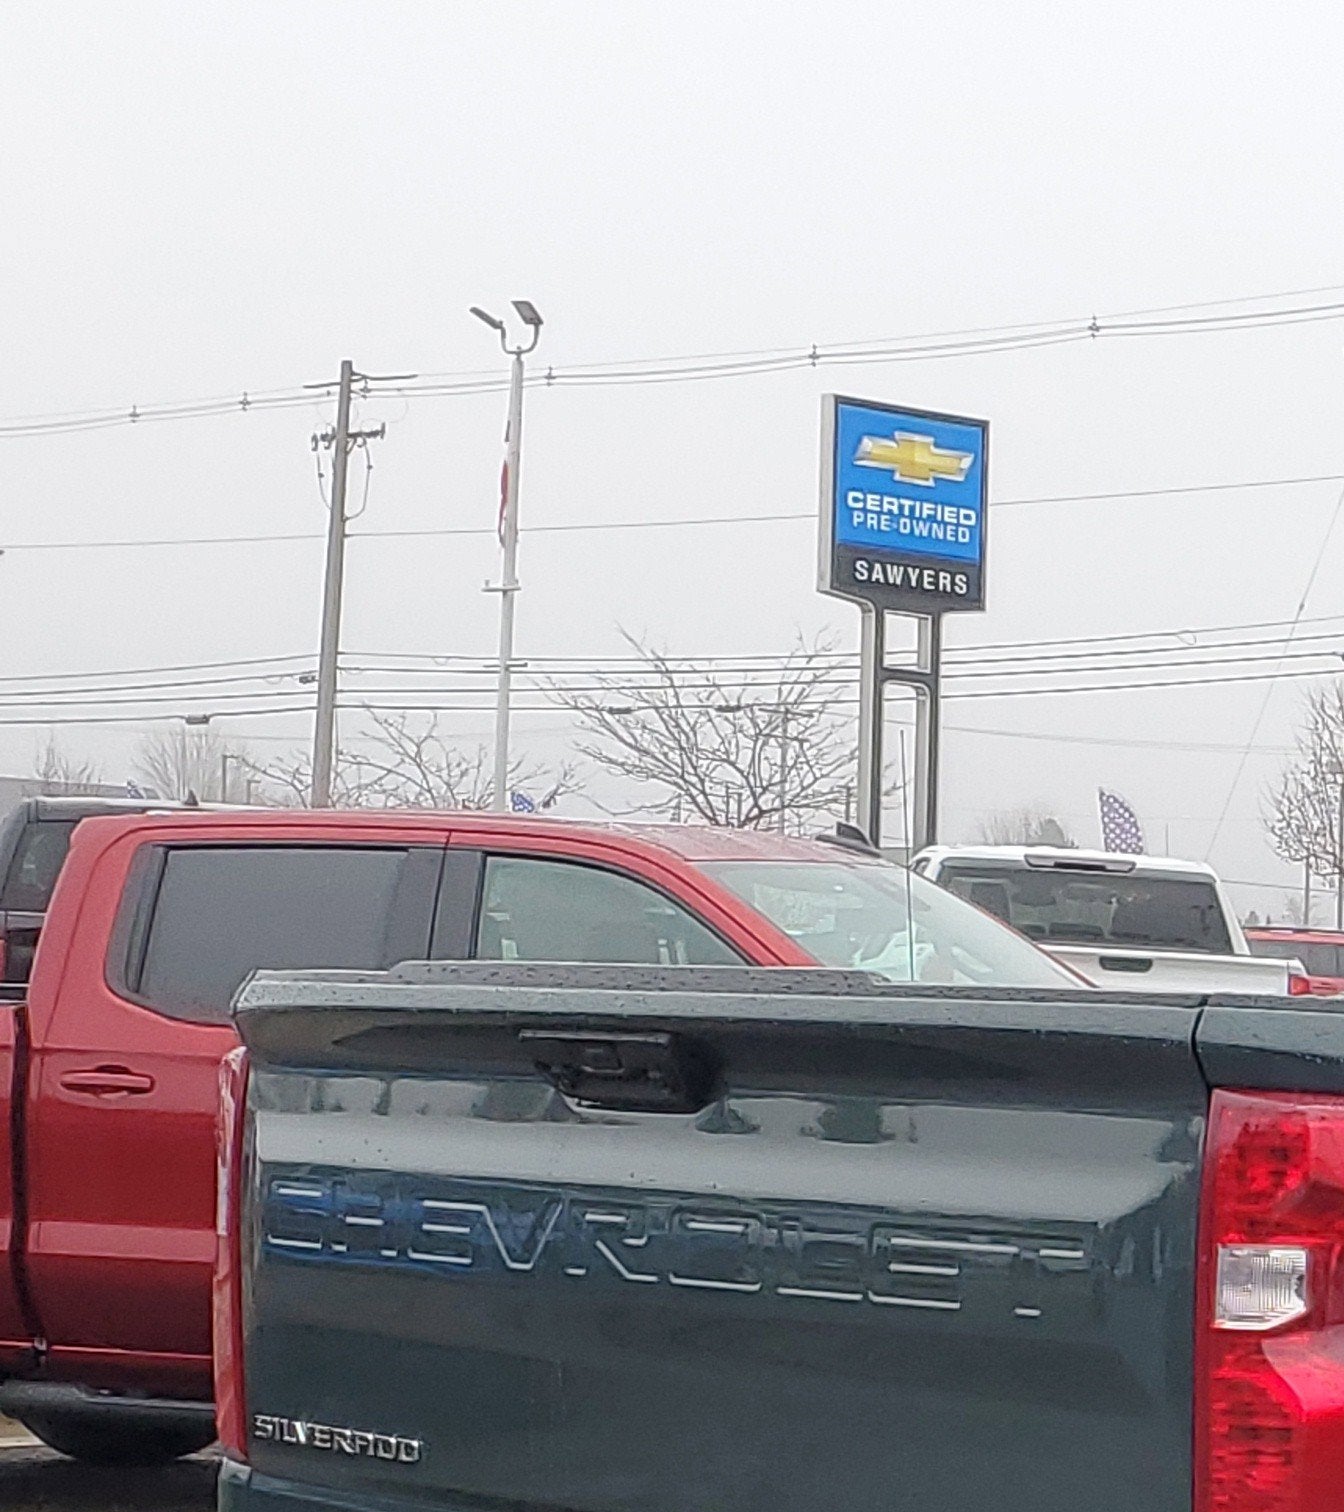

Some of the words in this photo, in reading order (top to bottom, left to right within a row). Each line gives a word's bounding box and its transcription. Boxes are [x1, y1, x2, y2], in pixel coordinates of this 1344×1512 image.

[846, 490, 977, 527] CERTIFIED
[852, 510, 970, 544] PRE-OWNED
[854, 559, 968, 595] SAWYERS
[266, 1180, 1094, 1318] CHEVROLET
[254, 1414, 420, 1463] SILVERADO
